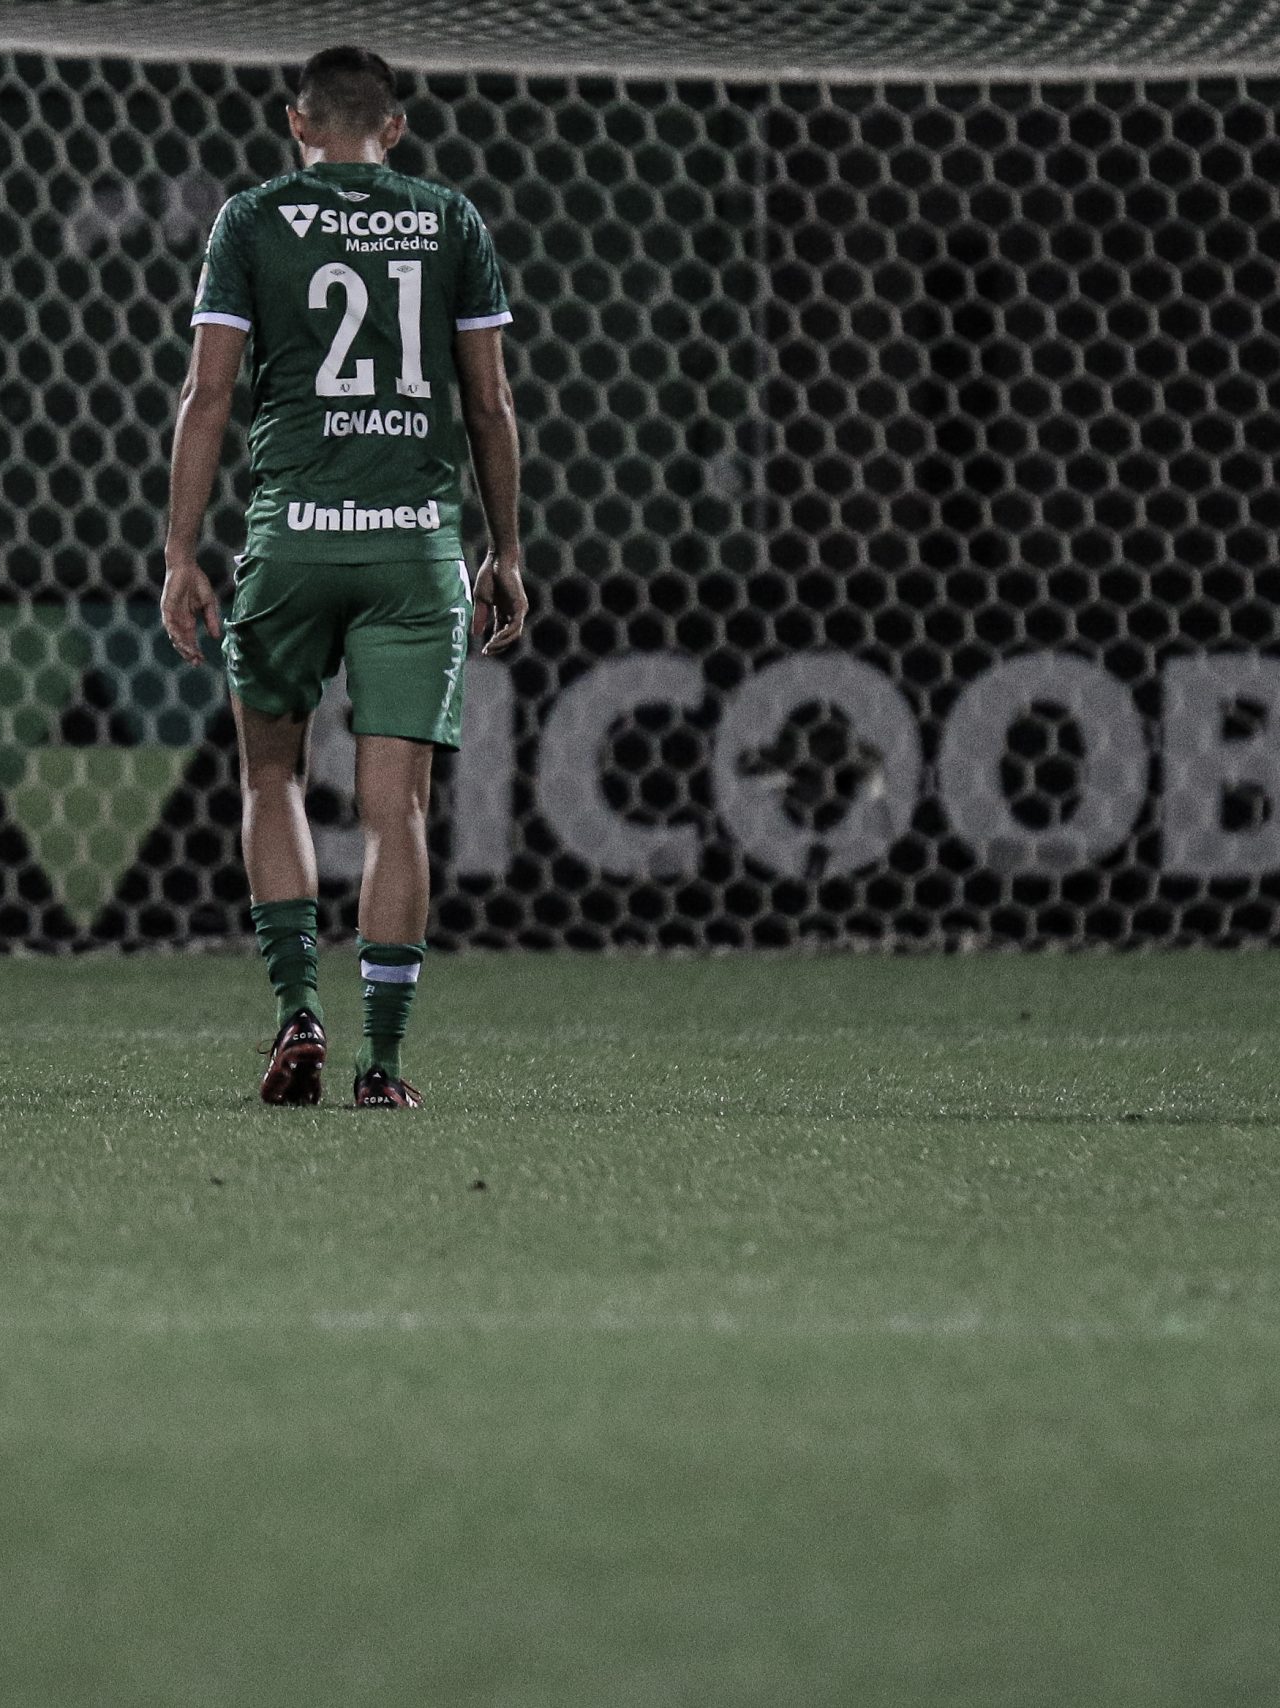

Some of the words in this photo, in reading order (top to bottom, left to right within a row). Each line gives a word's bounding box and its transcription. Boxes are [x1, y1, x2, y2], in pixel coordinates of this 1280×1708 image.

[320, 209, 439, 236] SICOOB
[345, 236, 439, 252] MaxiCrédito
[308, 260, 431, 398] 21
[323, 409, 428, 438] IGNACIO
[287, 500, 440, 531] Unimed
[308, 652, 1280, 882] ICOOB
[292, 1032, 319, 1041] COPA
[363, 1096, 391, 1105] COPA
